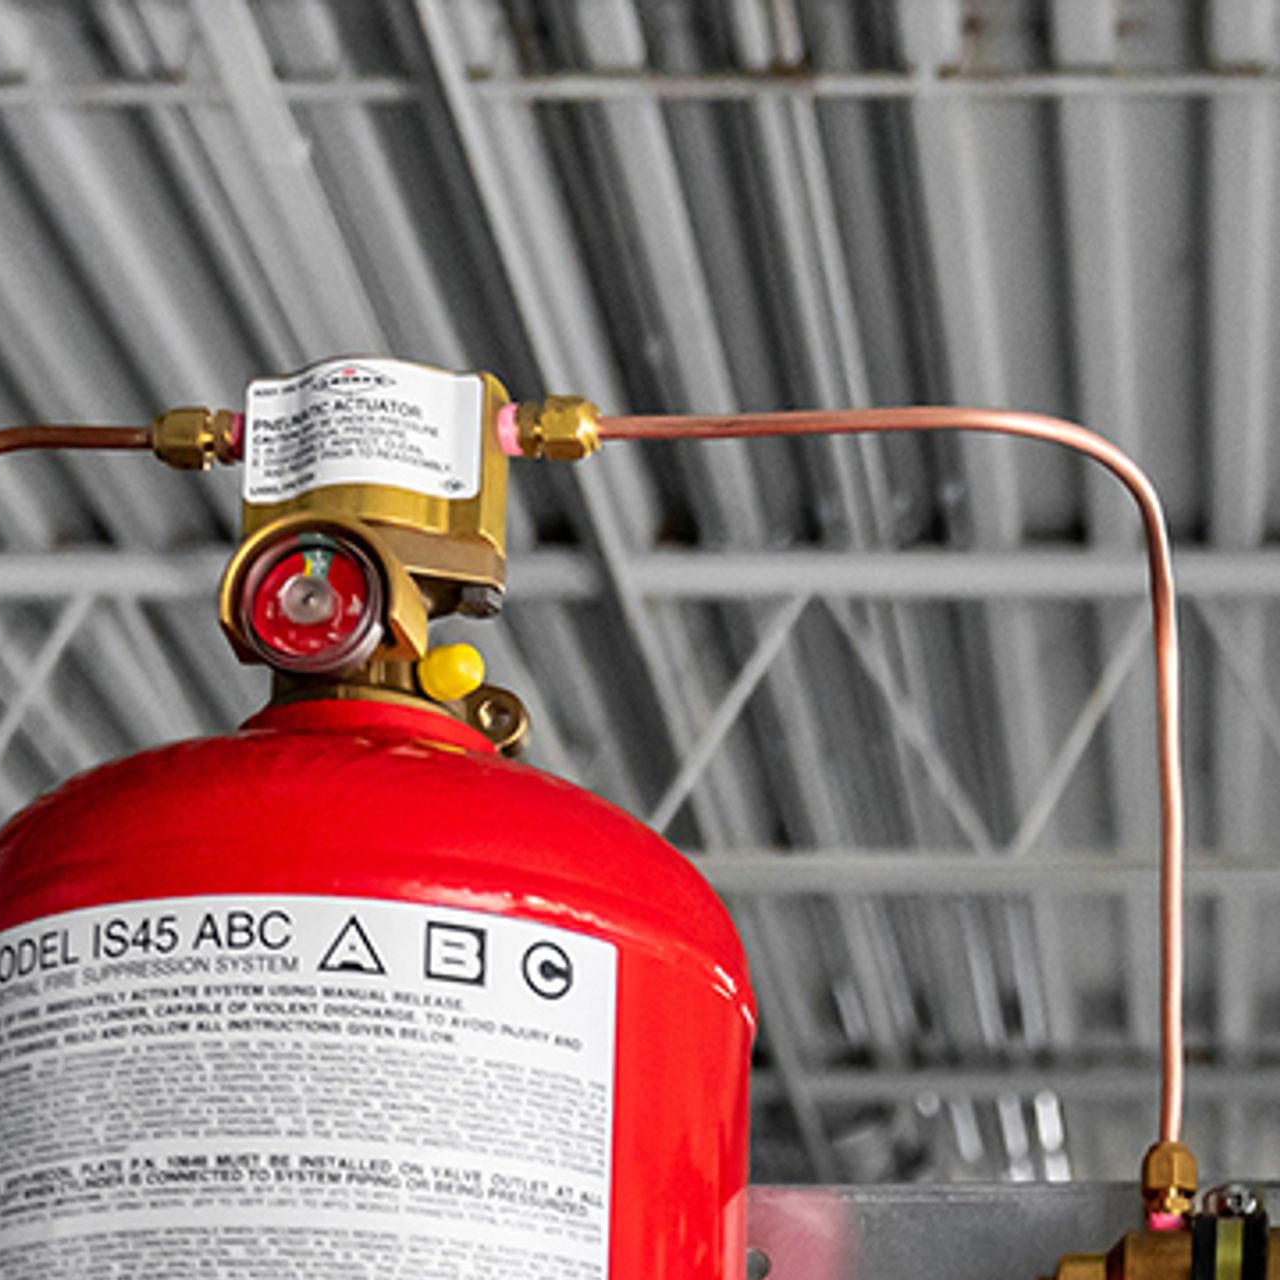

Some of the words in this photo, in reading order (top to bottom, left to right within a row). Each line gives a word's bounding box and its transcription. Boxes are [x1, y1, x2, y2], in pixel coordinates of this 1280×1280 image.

[92, 915, 180, 960] IS45
[192, 909, 294, 951] ABC
[81, 956, 209, 985] SUPPRESSION
[214, 956, 300, 974] SYSTEM
[228, 1001, 248, 1015] OF
[427, 1008, 446, 1024] TO
[347, 1022, 396, 1039] GIVEN
[146, 1169, 243, 1186] CONNECTED
[248, 1169, 271, 1183] TO
